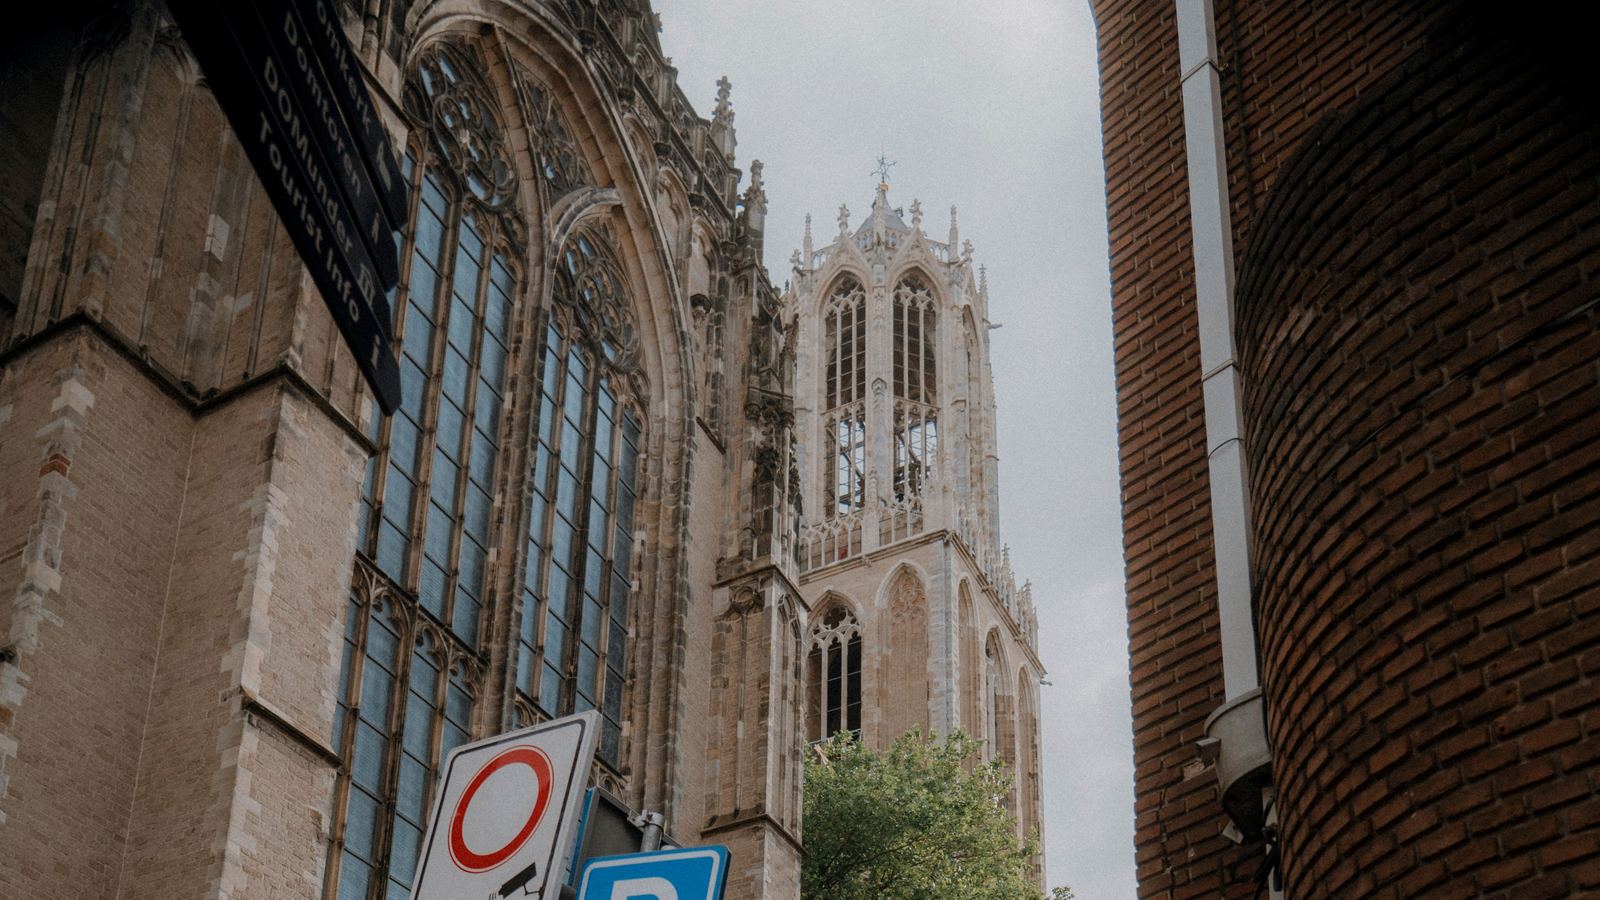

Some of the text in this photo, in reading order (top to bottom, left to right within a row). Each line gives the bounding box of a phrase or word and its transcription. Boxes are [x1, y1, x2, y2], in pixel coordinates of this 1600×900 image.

[264, 56, 352, 253] DOMunder
[284, 11, 361, 197] Domtoren
[316, 0, 371, 135] omkerk
[259, 111, 322, 254] Tourist
[326, 248, 360, 323] Info
